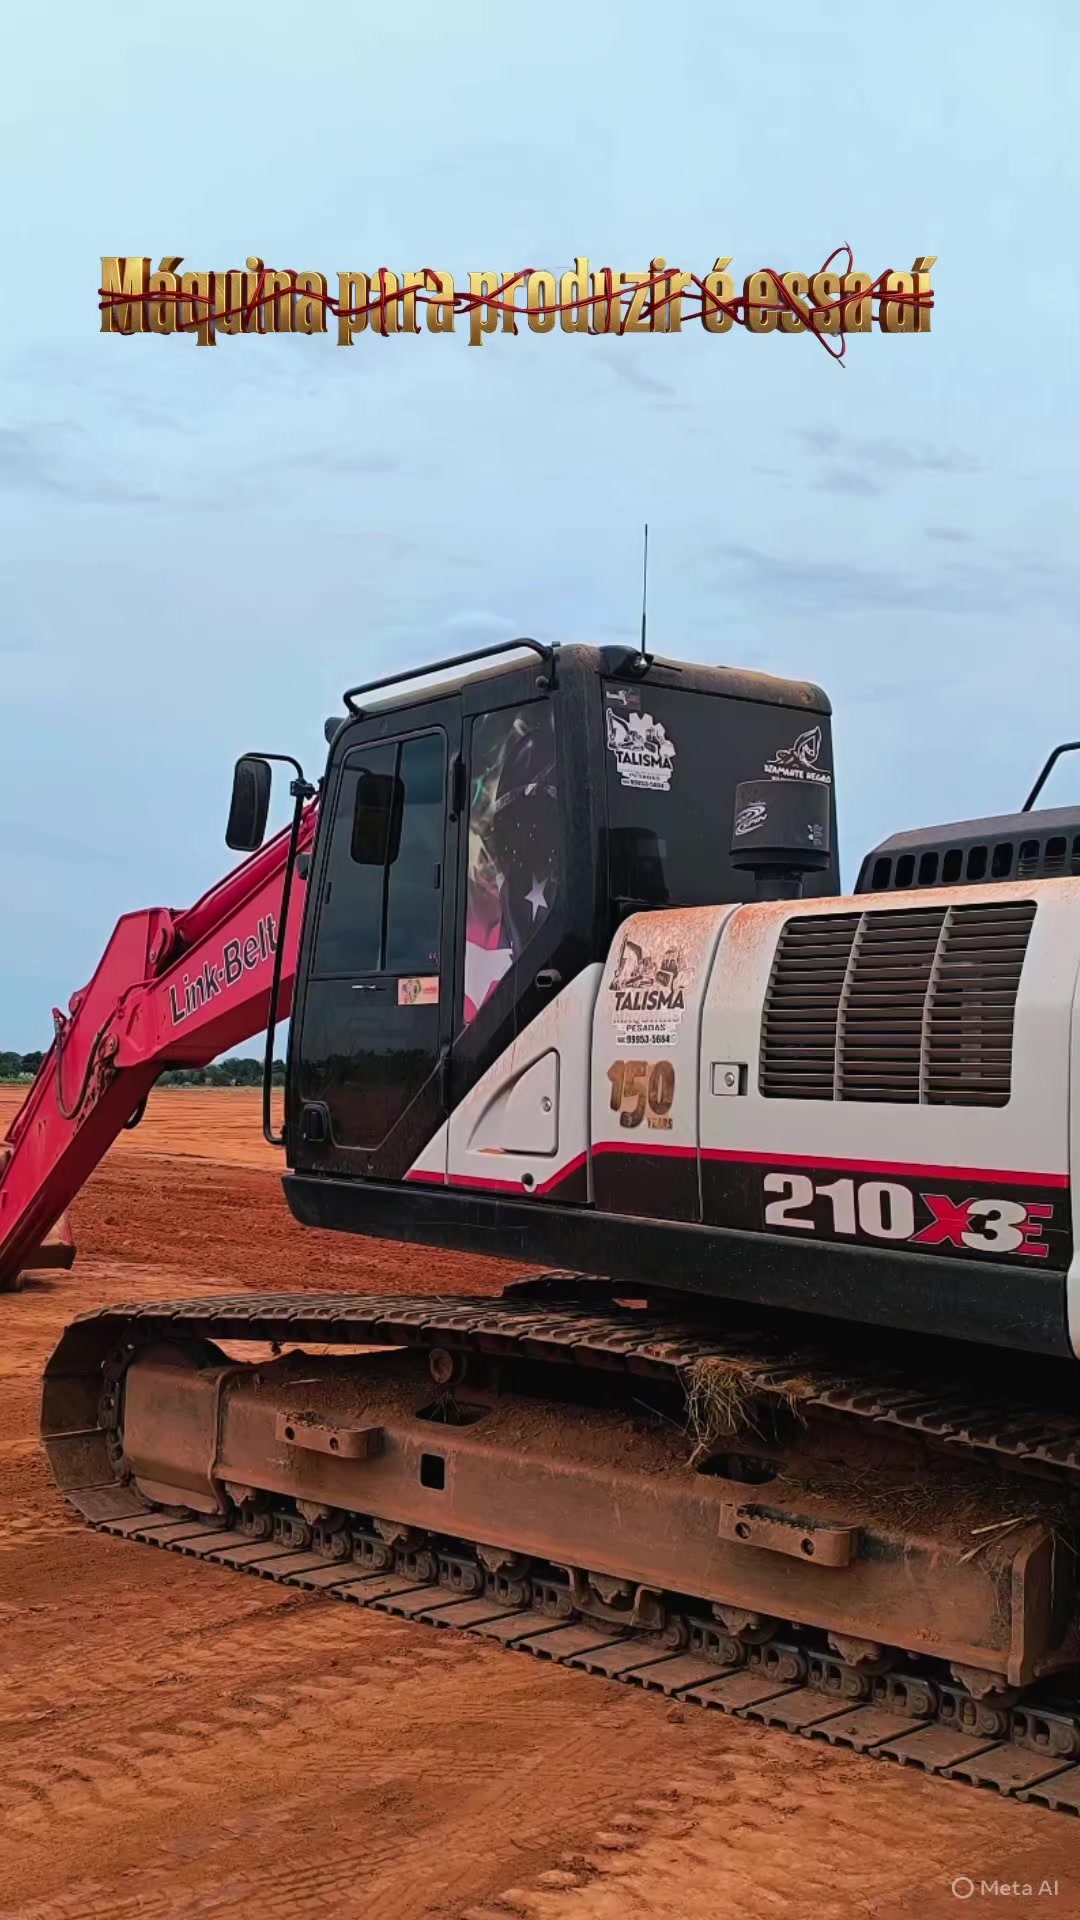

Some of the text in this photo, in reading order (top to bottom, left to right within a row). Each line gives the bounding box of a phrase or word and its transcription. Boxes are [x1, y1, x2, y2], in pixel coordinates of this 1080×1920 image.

[169, 913, 277, 1026] Link-Belt
[626, 1023, 667, 1033] PESADAS
[607, 1060, 675, 1128] 150
